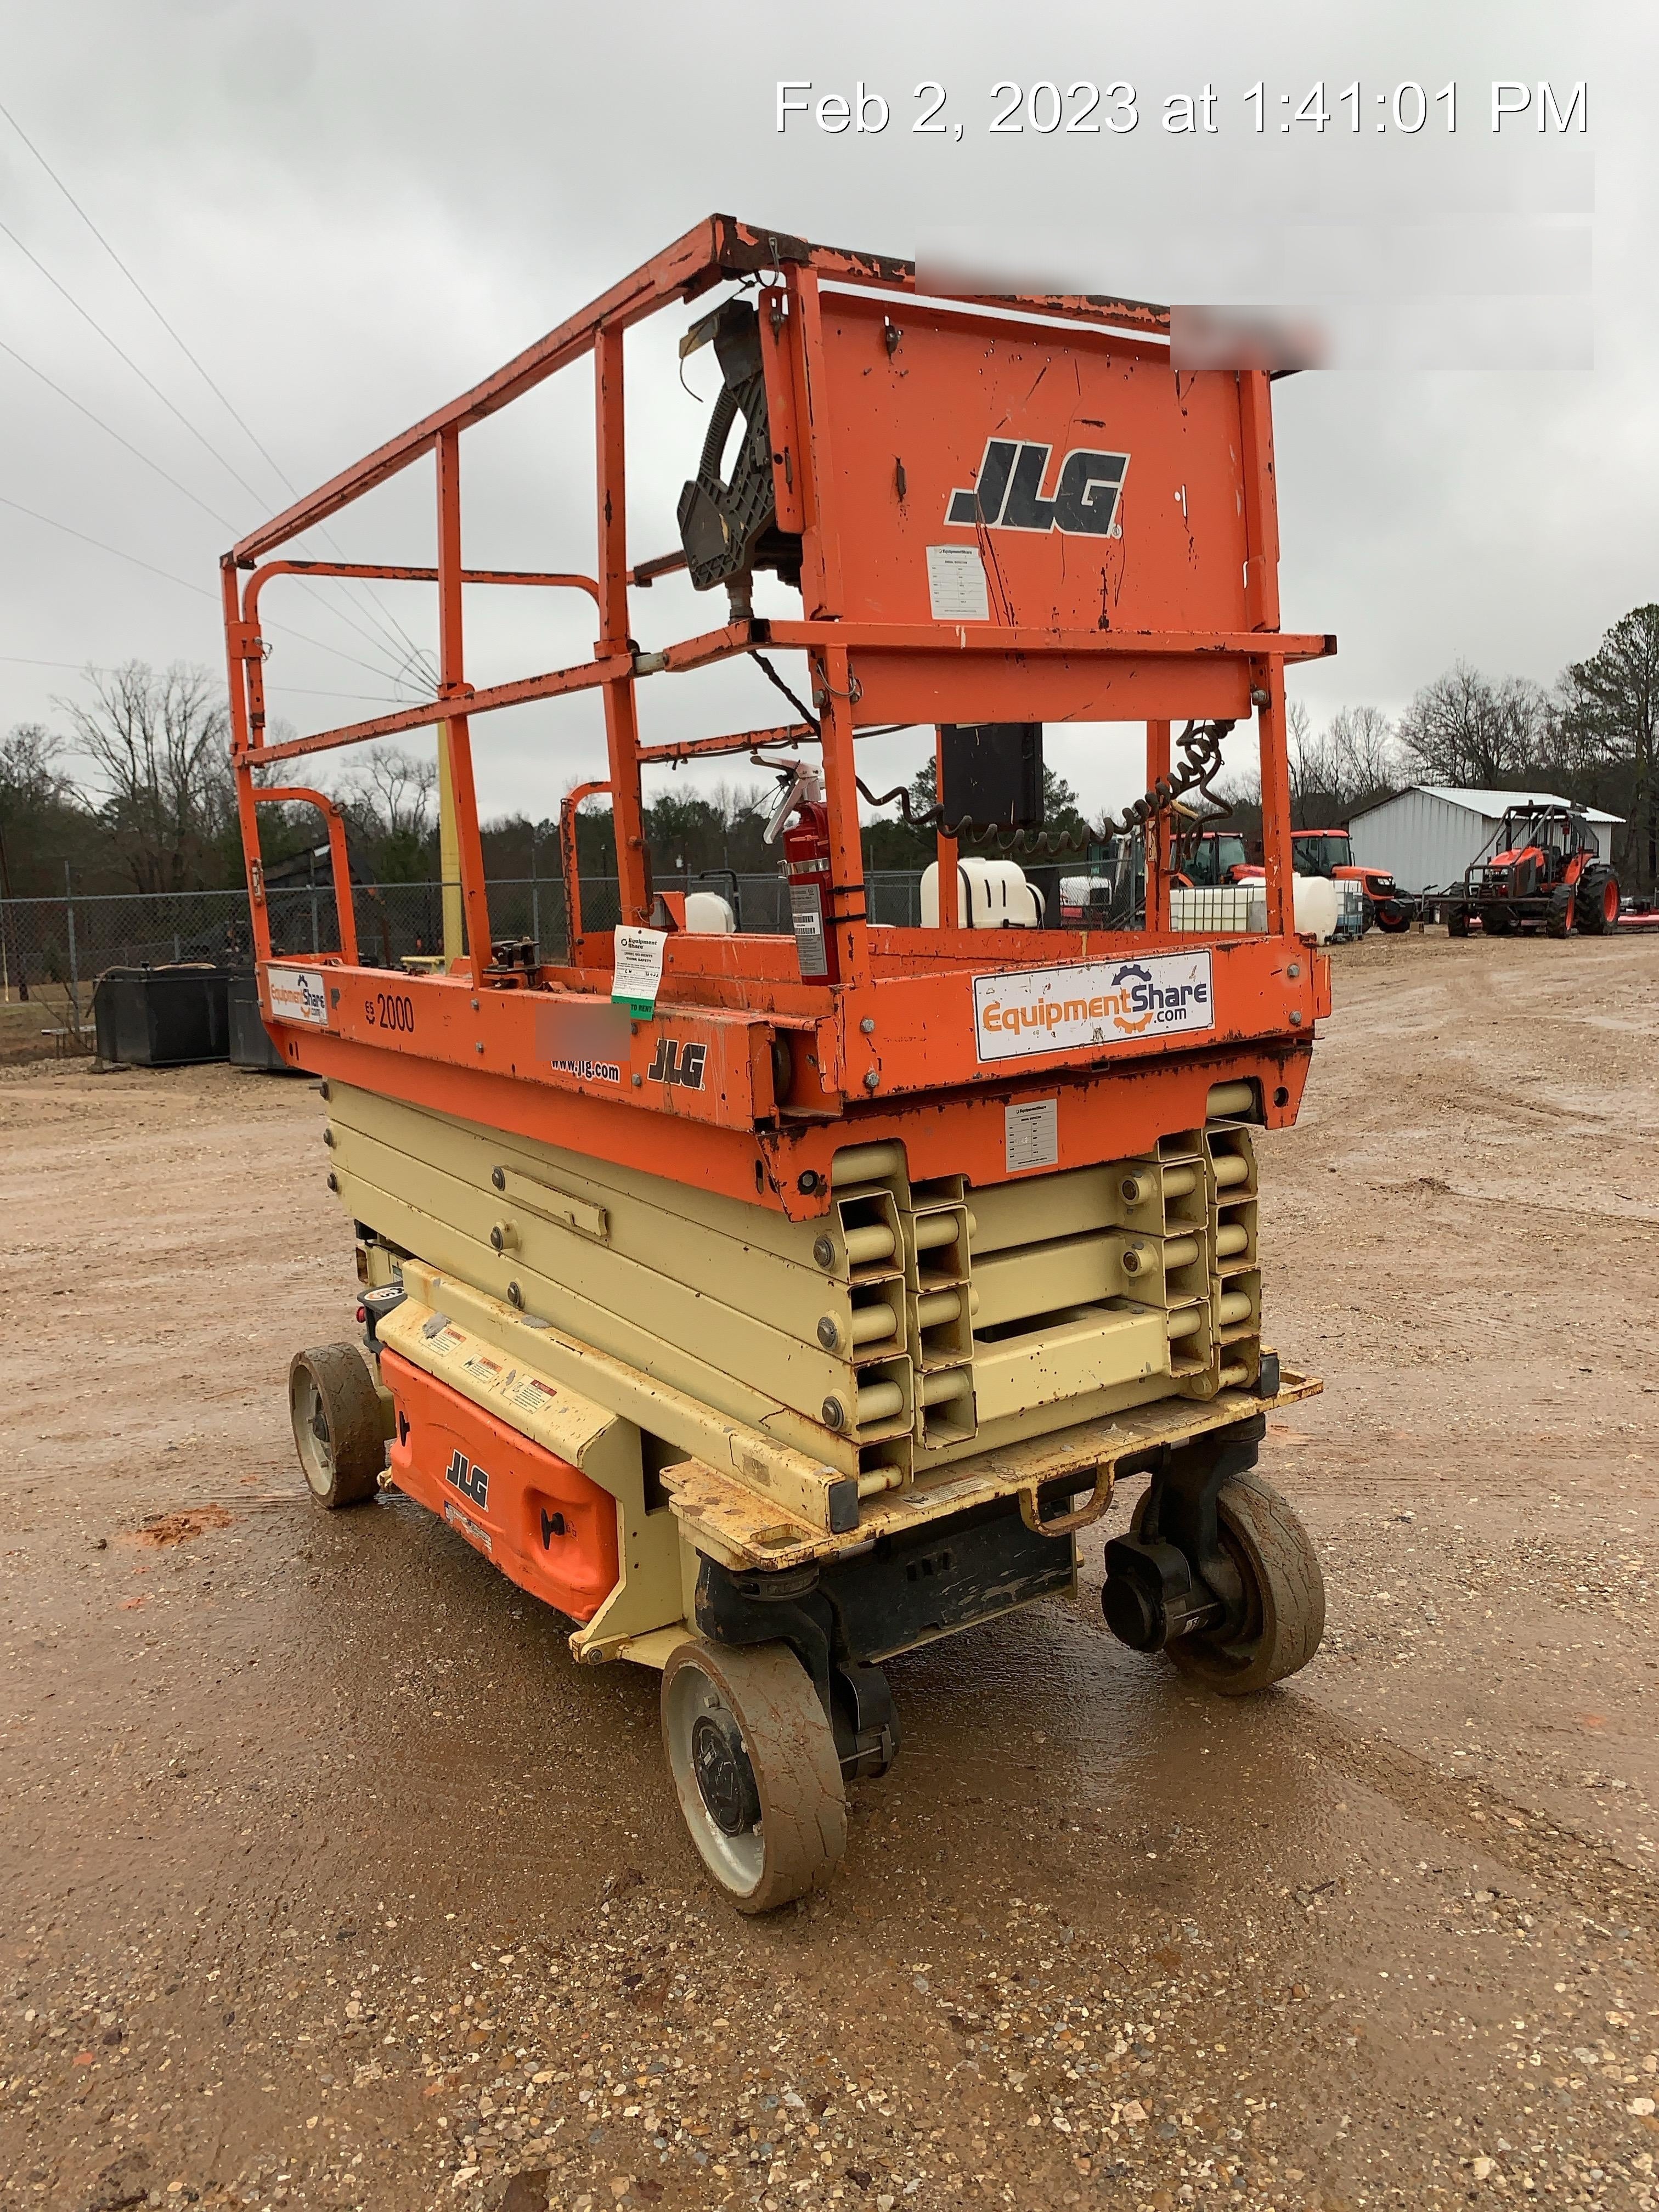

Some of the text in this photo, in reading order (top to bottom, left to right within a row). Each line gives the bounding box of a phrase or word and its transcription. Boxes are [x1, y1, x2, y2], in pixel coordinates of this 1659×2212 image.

[945, 438, 1131, 538] JLG
[271, 985, 325, 1008] EquipmentShare
[377, 993, 414, 1033] 2000
[639, 1005, 652, 1013] RENT
[983, 983, 1207, 1035] EquipmentShare
[1153, 1008, 1187, 1024] .com
[647, 1038, 707, 1090] JLG
[445, 1449, 489, 1511] JLG
